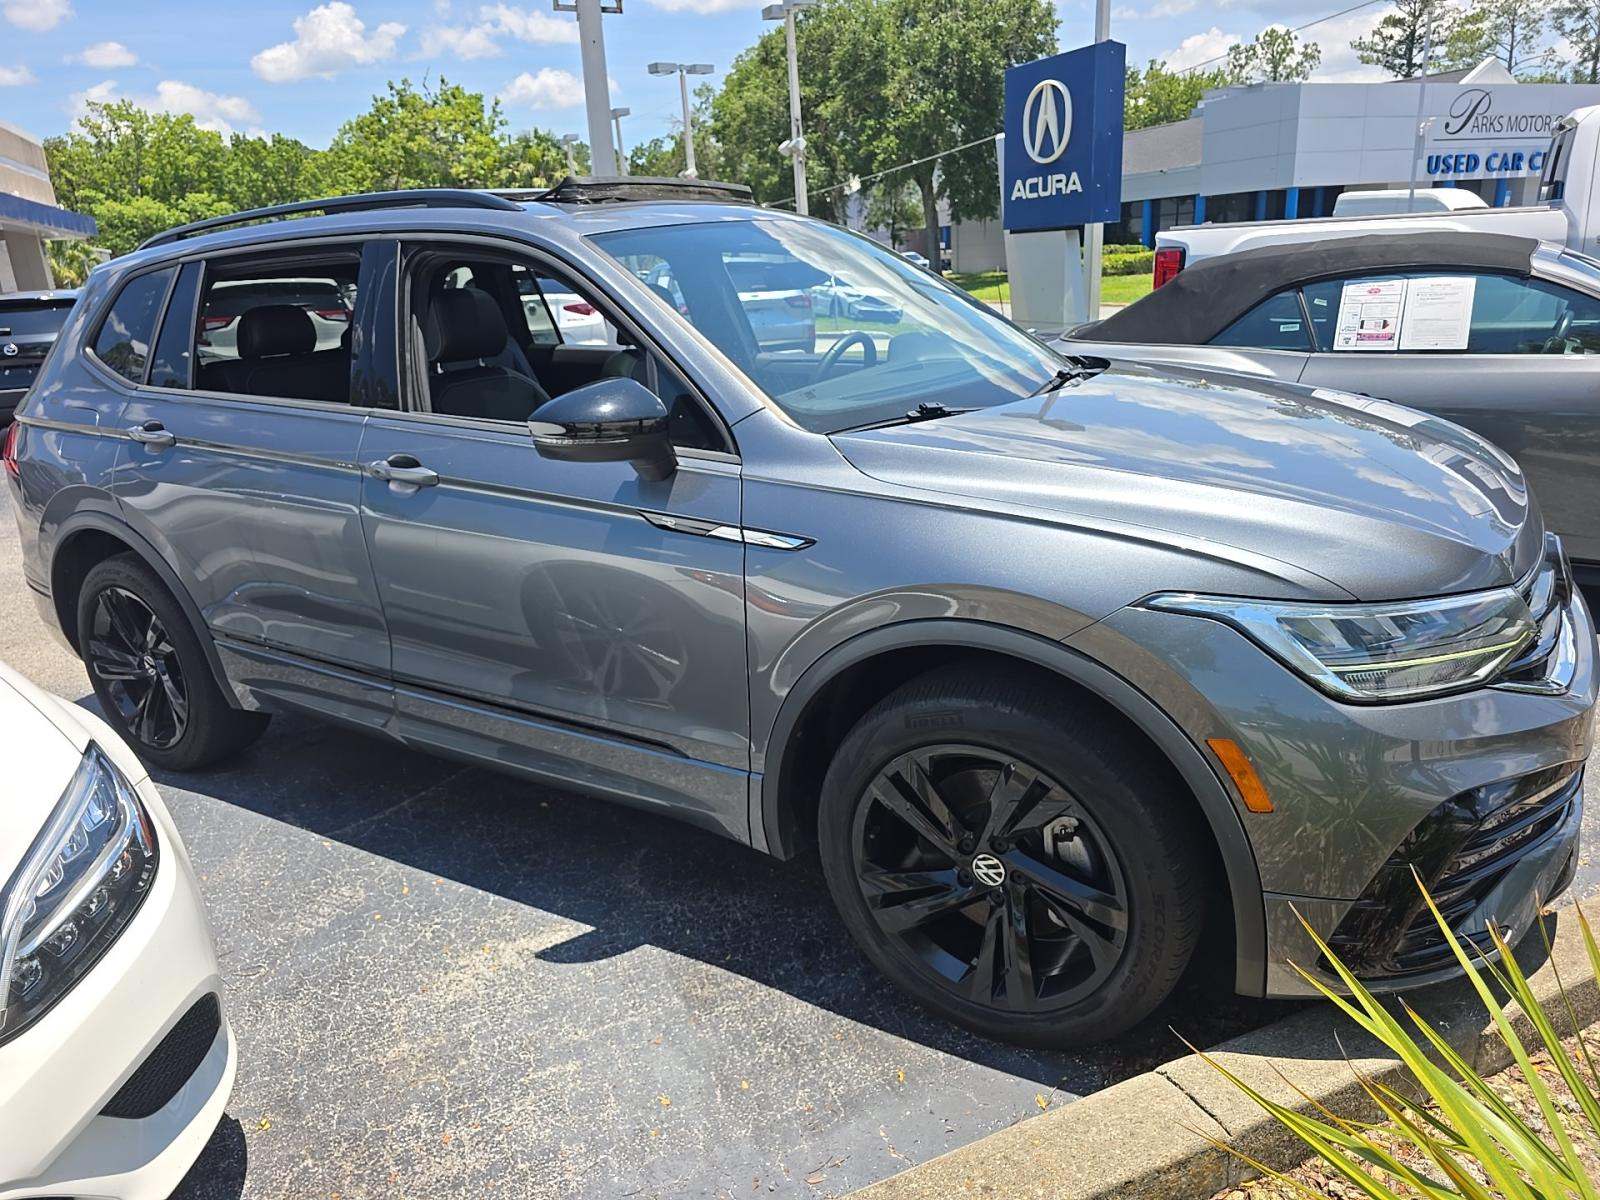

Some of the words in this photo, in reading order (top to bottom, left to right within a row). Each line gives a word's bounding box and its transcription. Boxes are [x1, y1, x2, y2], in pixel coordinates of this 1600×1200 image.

[1444, 88, 1504, 135] PARKS
[1506, 114, 1552, 133] MOTOR
[1426, 152, 1480, 175] USED
[1485, 151, 1525, 172] CAR
[1010, 170, 1083, 201] ACURA
